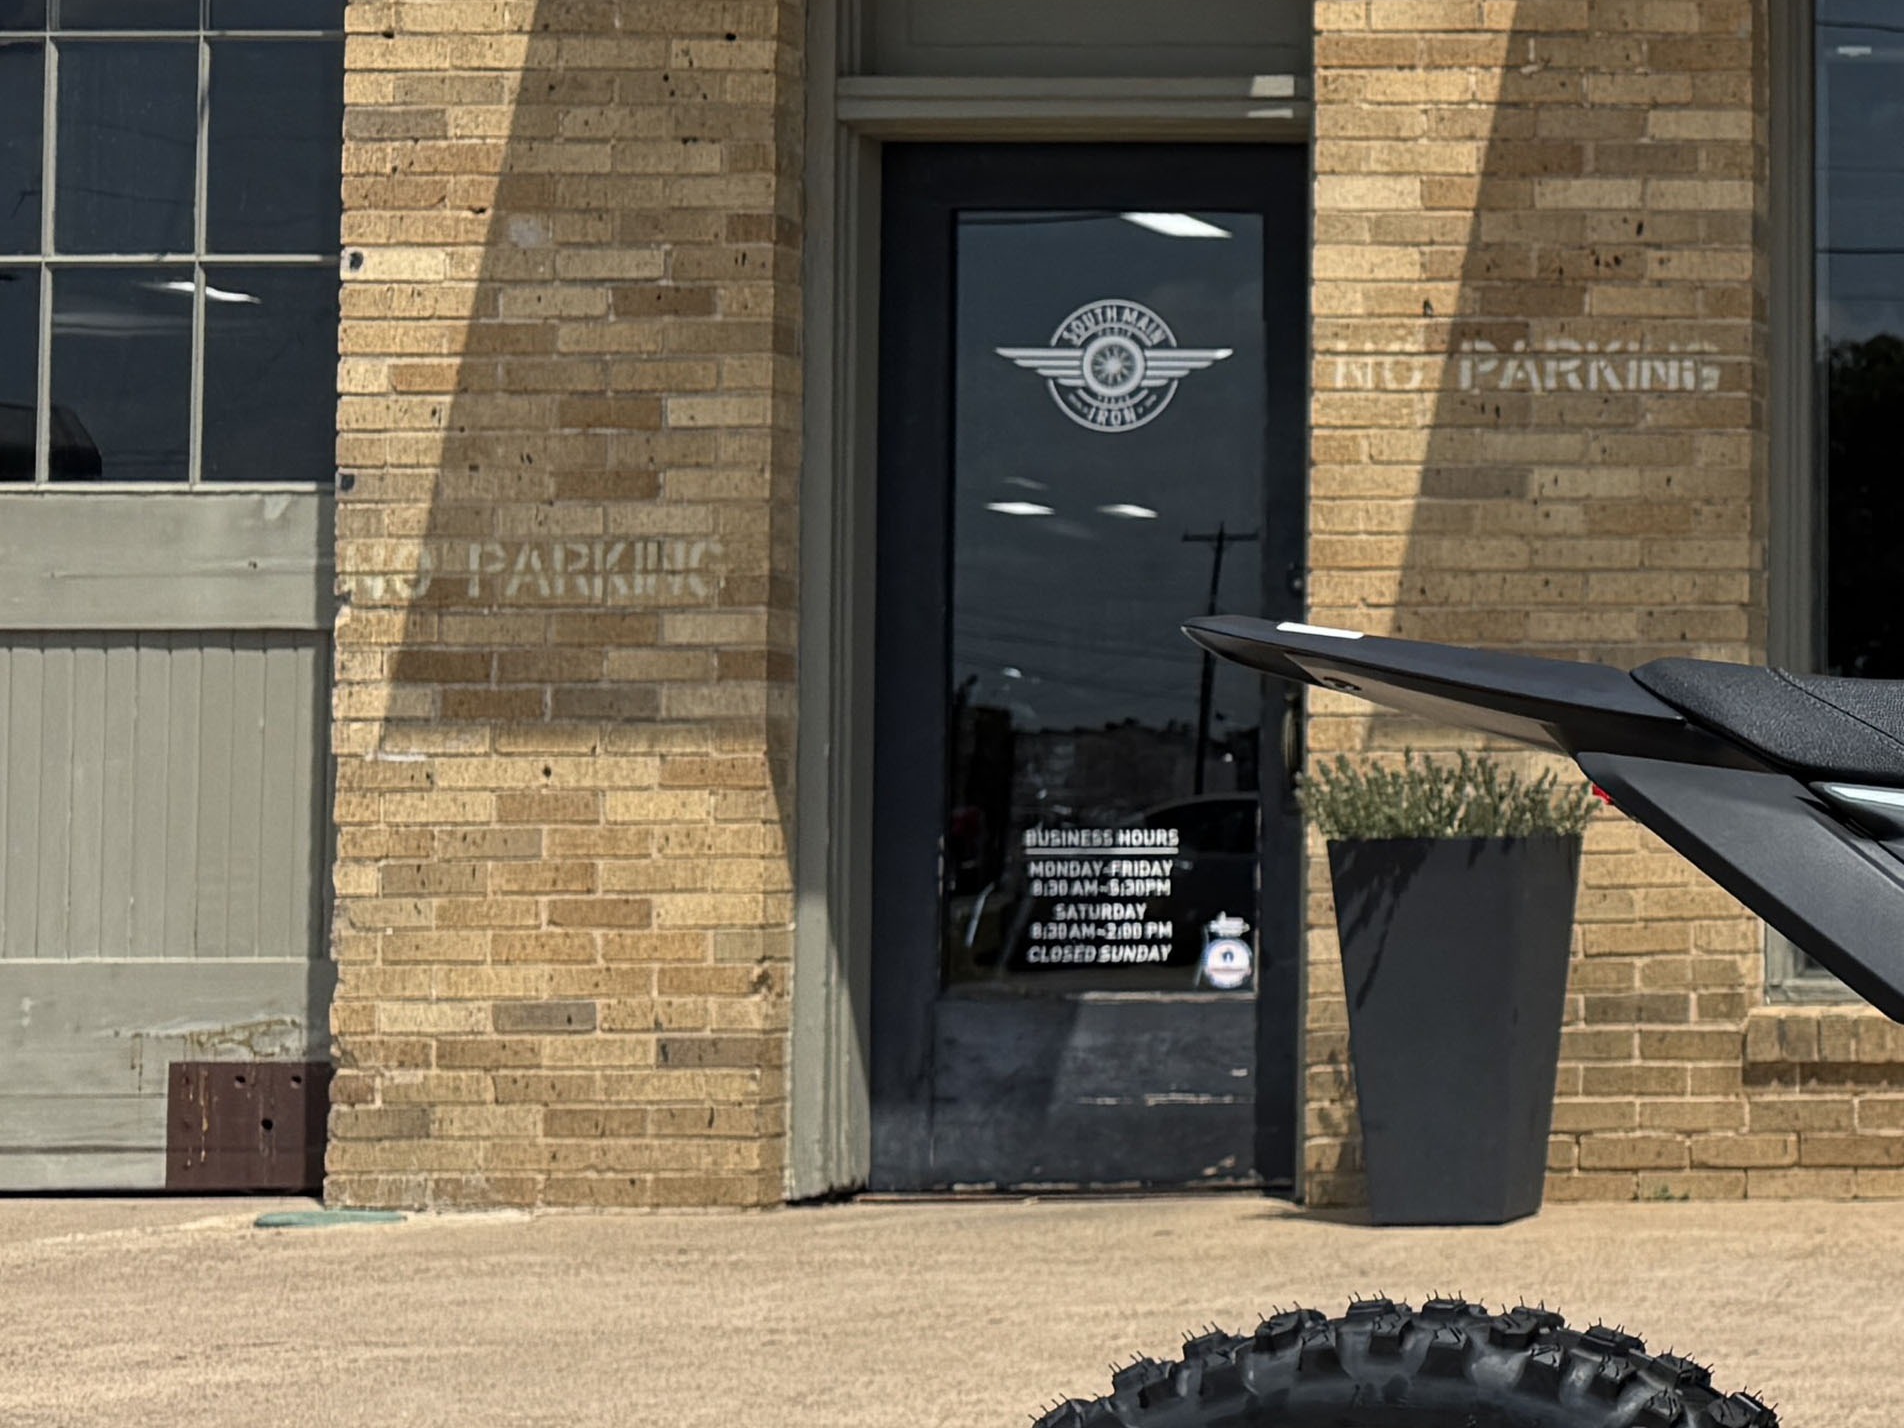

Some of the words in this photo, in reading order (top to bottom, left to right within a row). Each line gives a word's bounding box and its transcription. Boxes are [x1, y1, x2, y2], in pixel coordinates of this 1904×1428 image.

[1062, 305, 1117, 346] SOUTH
[1121, 307, 1166, 346] MAIN
[1333, 340, 1423, 391] NO
[1458, 339, 1721, 392] PARKING
[1087, 407, 1137, 427] IRON
[468, 539, 725, 599] PARKING
[1024, 828, 1113, 847] BUSINESS
[1116, 828, 1179, 847] HOURS
[1052, 902, 1147, 921] SATURDAY
[1145, 921, 1173, 939] PM
[1027, 944, 1097, 963] CLOSED
[1098, 943, 1173, 963] SUNDAY
